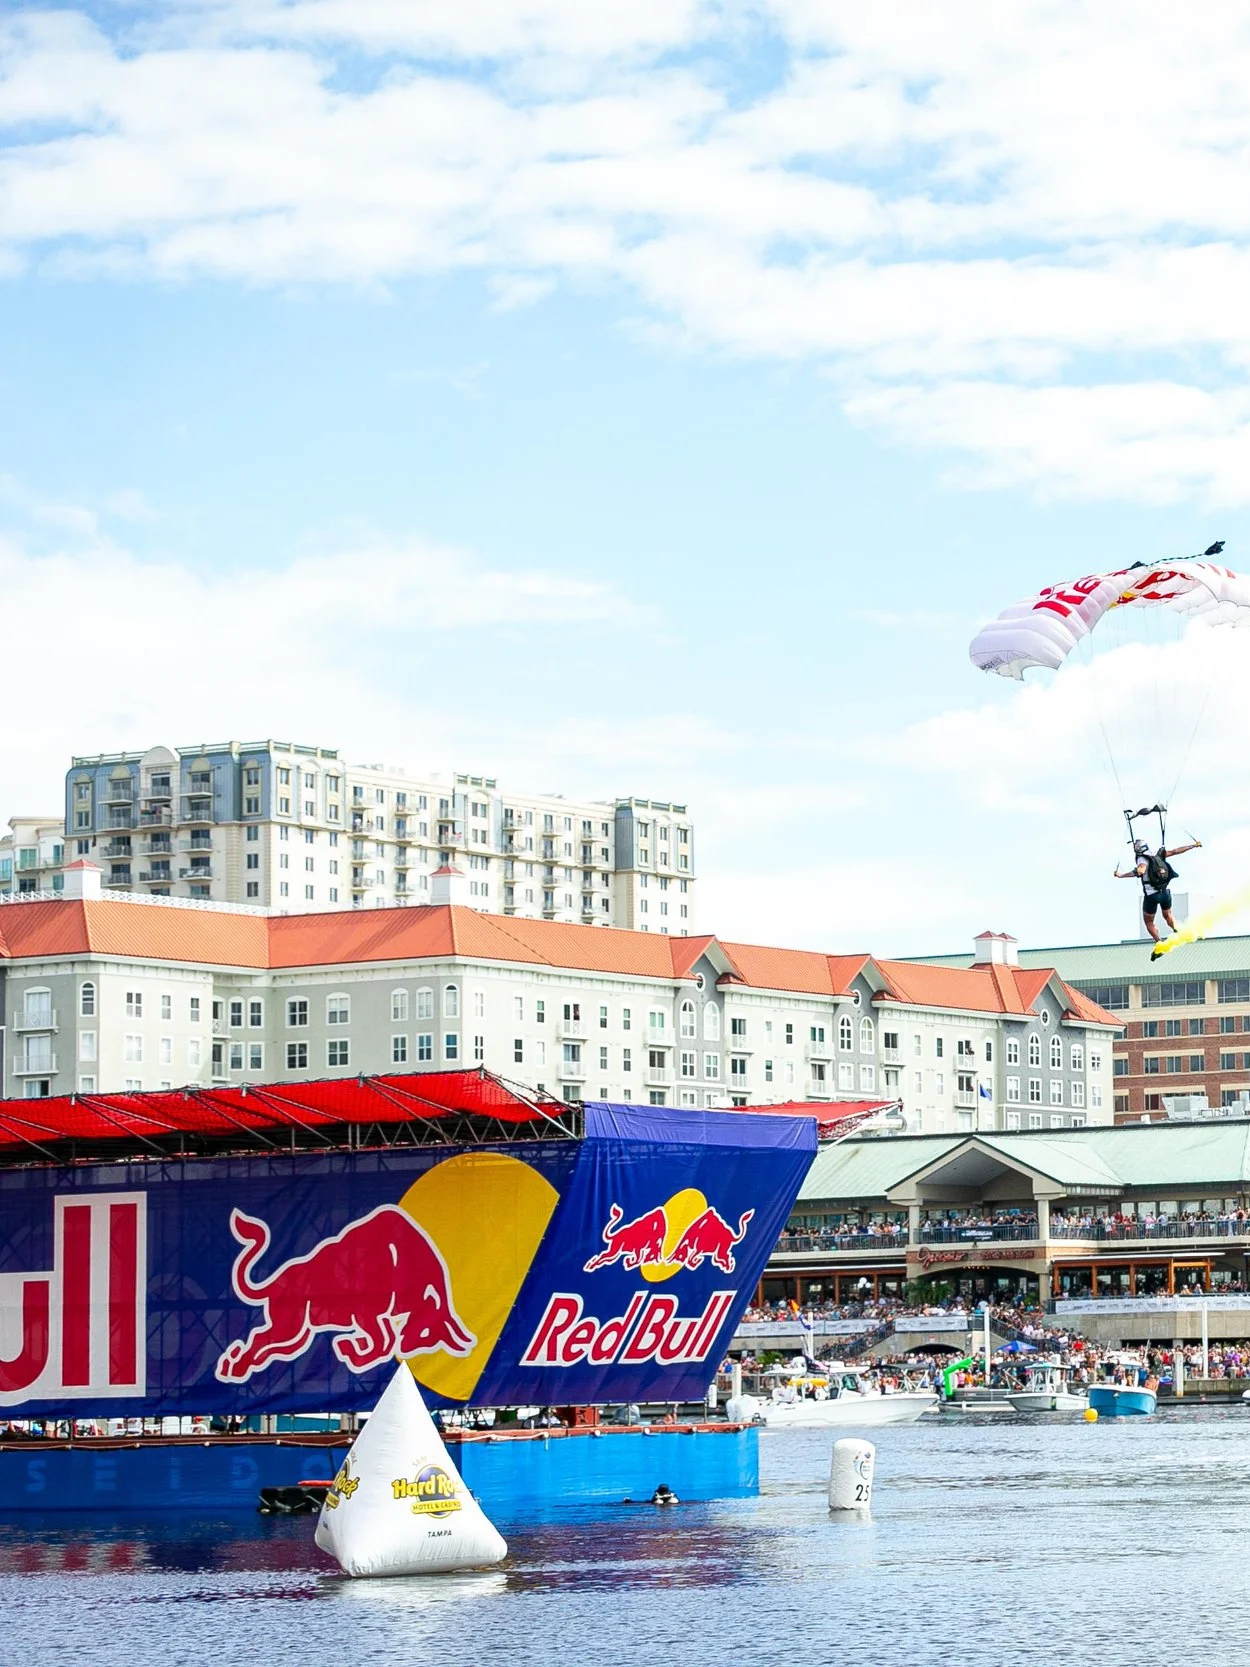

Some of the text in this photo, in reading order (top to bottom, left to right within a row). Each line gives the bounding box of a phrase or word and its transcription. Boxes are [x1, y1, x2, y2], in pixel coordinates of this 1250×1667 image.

[520, 1290, 737, 1366] Red Bull
[391, 1473, 460, 1500] Hard Ro
[412, 1503, 434, 1511] HOTEL
[427, 1530, 452, 1538] TAMPA
